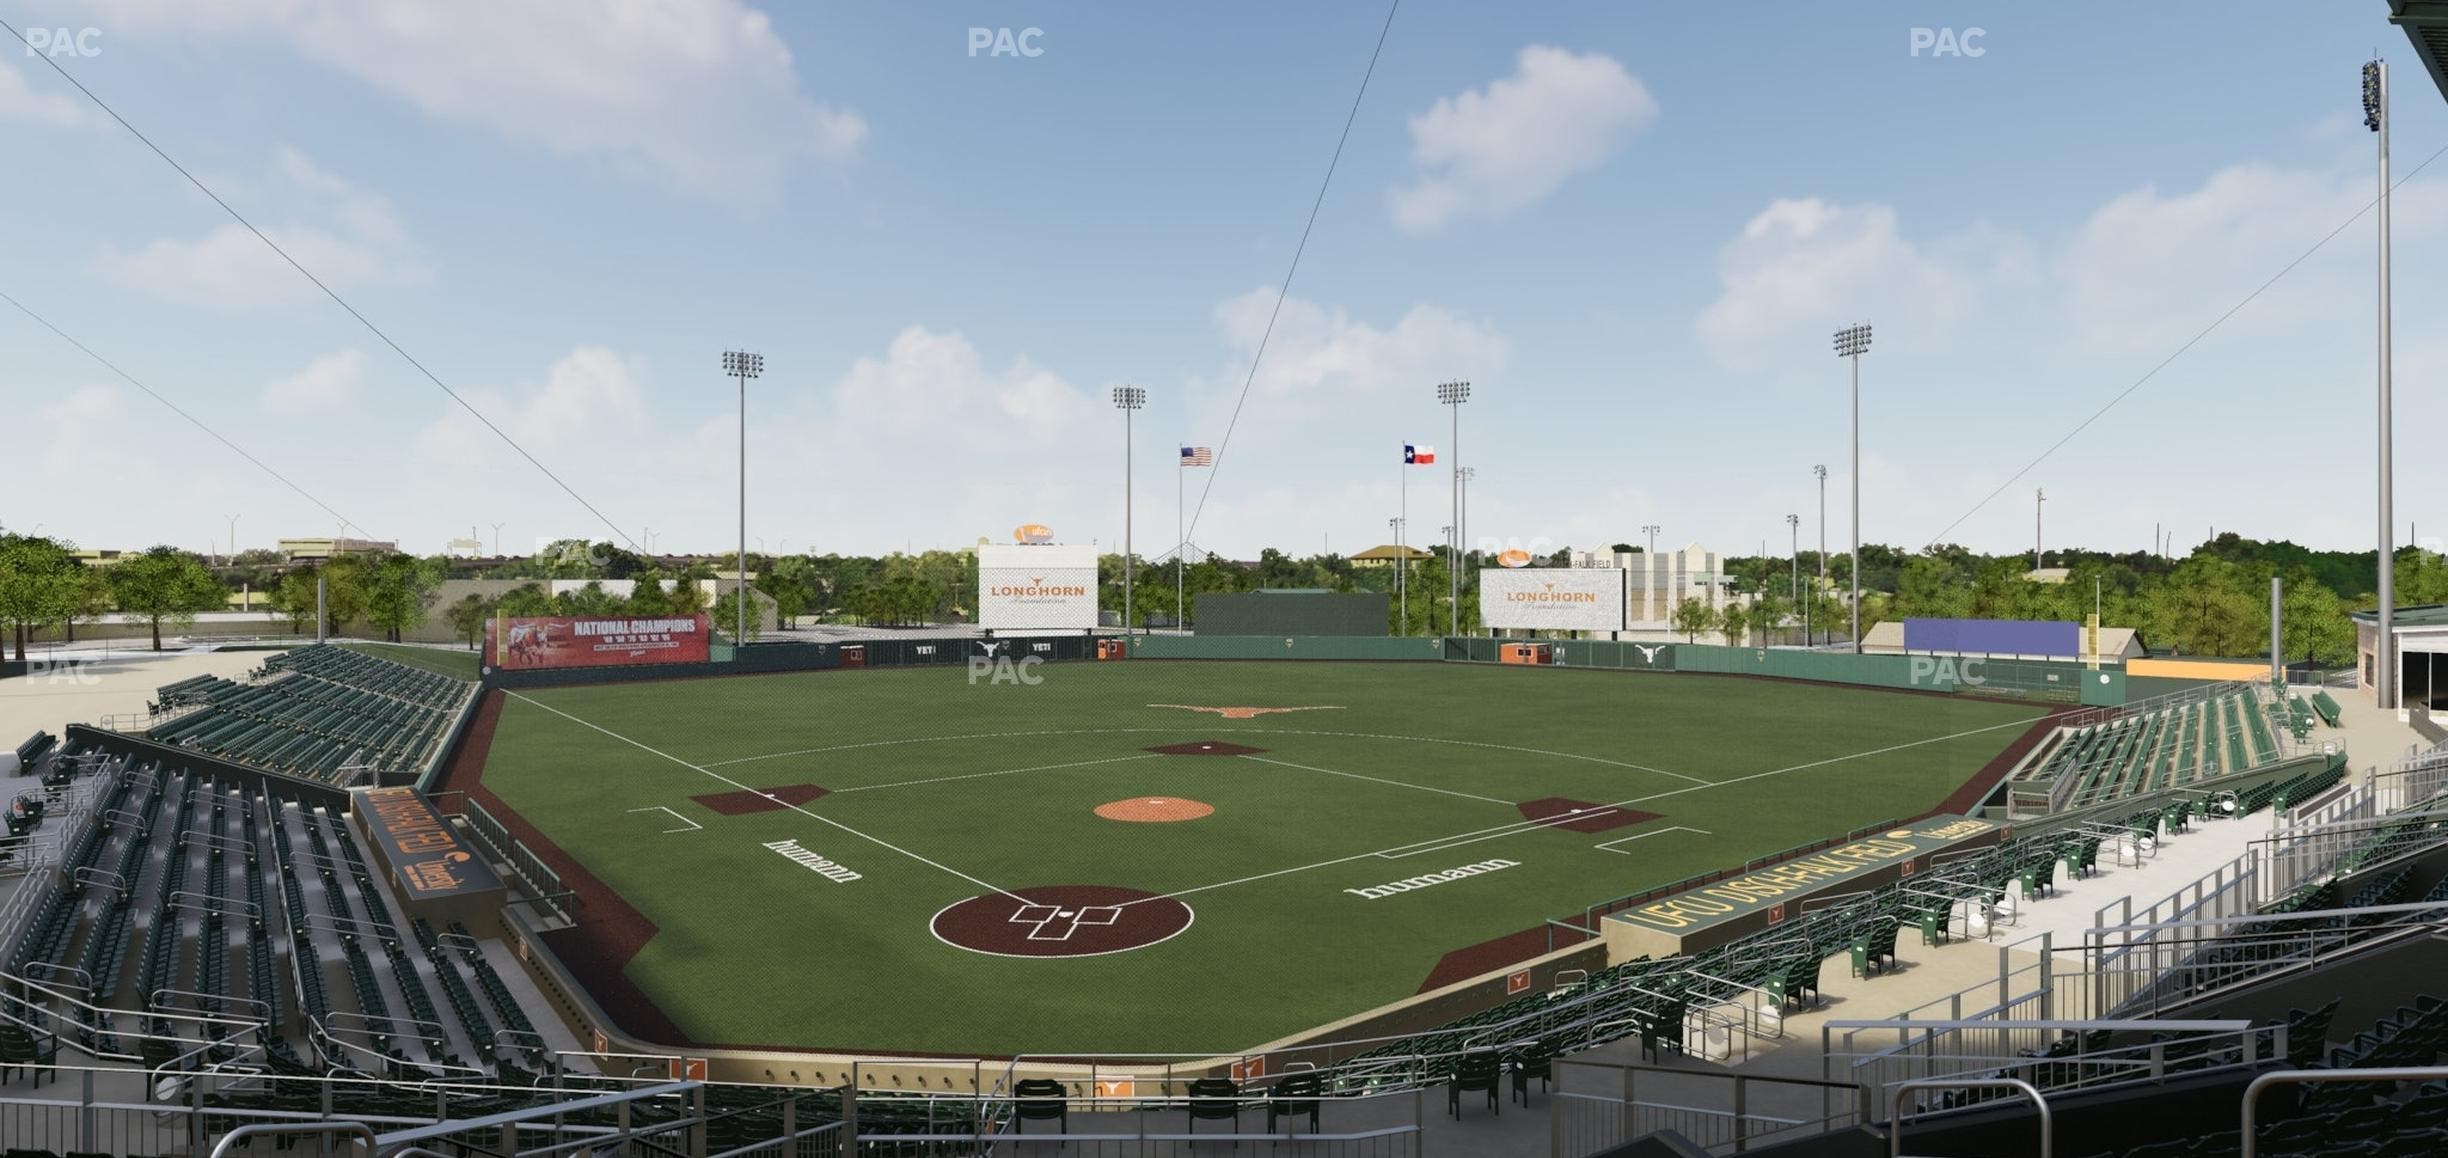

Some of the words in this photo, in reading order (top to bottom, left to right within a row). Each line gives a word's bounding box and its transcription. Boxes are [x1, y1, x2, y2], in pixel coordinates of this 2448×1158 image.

[991, 586, 1085, 597] LONGHORN
[1507, 592, 1596, 603] LONGHORN
[574, 621, 630, 636] NATIONAL
[631, 619, 696, 634] CHAMPIONS
[1032, 643, 1051, 651] YETI
[761, 839, 863, 883] humann
[1343, 859, 1522, 900] humann
[1625, 895, 1734, 928] UFCU
